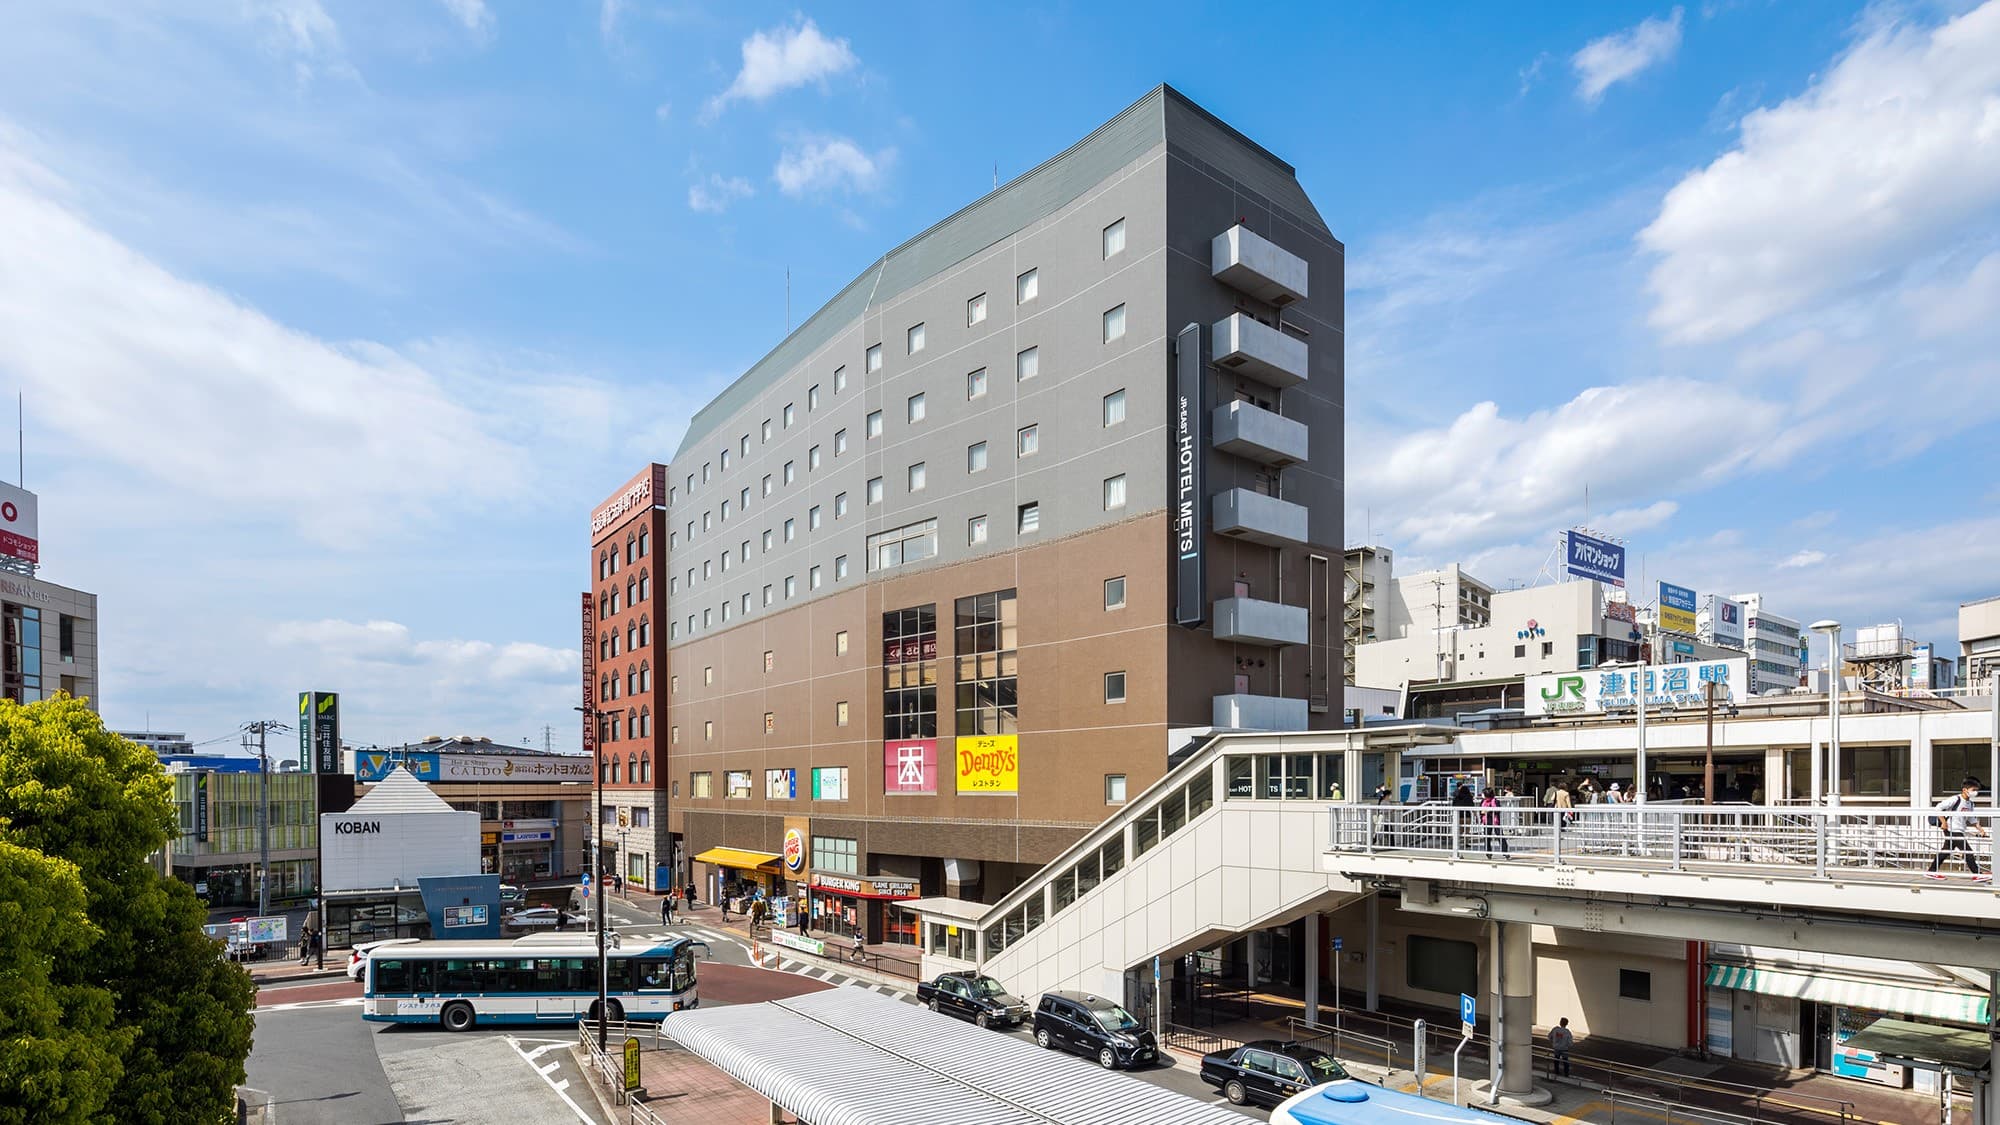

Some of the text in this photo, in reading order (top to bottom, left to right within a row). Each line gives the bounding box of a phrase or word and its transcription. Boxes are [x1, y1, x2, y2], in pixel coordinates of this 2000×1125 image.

[1180, 396, 1193, 552] JR-EAST HOTEL METS
[3, 536, 36, 552] ドコモショップ
[1575, 541, 1620, 570] アパマンショップ
[1541, 676, 1584, 699] JR
[1599, 664, 1729, 695] 津田沼駅
[1596, 694, 1672, 707] TSUDAUMA
[960, 746, 1015, 776] Denny's
[451, 766, 502, 776] CALDO
[335, 822, 380, 833] KOBAN
[786, 844, 800, 855] KING
[820, 875, 860, 892] BURGER KING
[399, 1001, 440, 1009] ノンステップバス
[1465, 998, 1473, 1020] P
